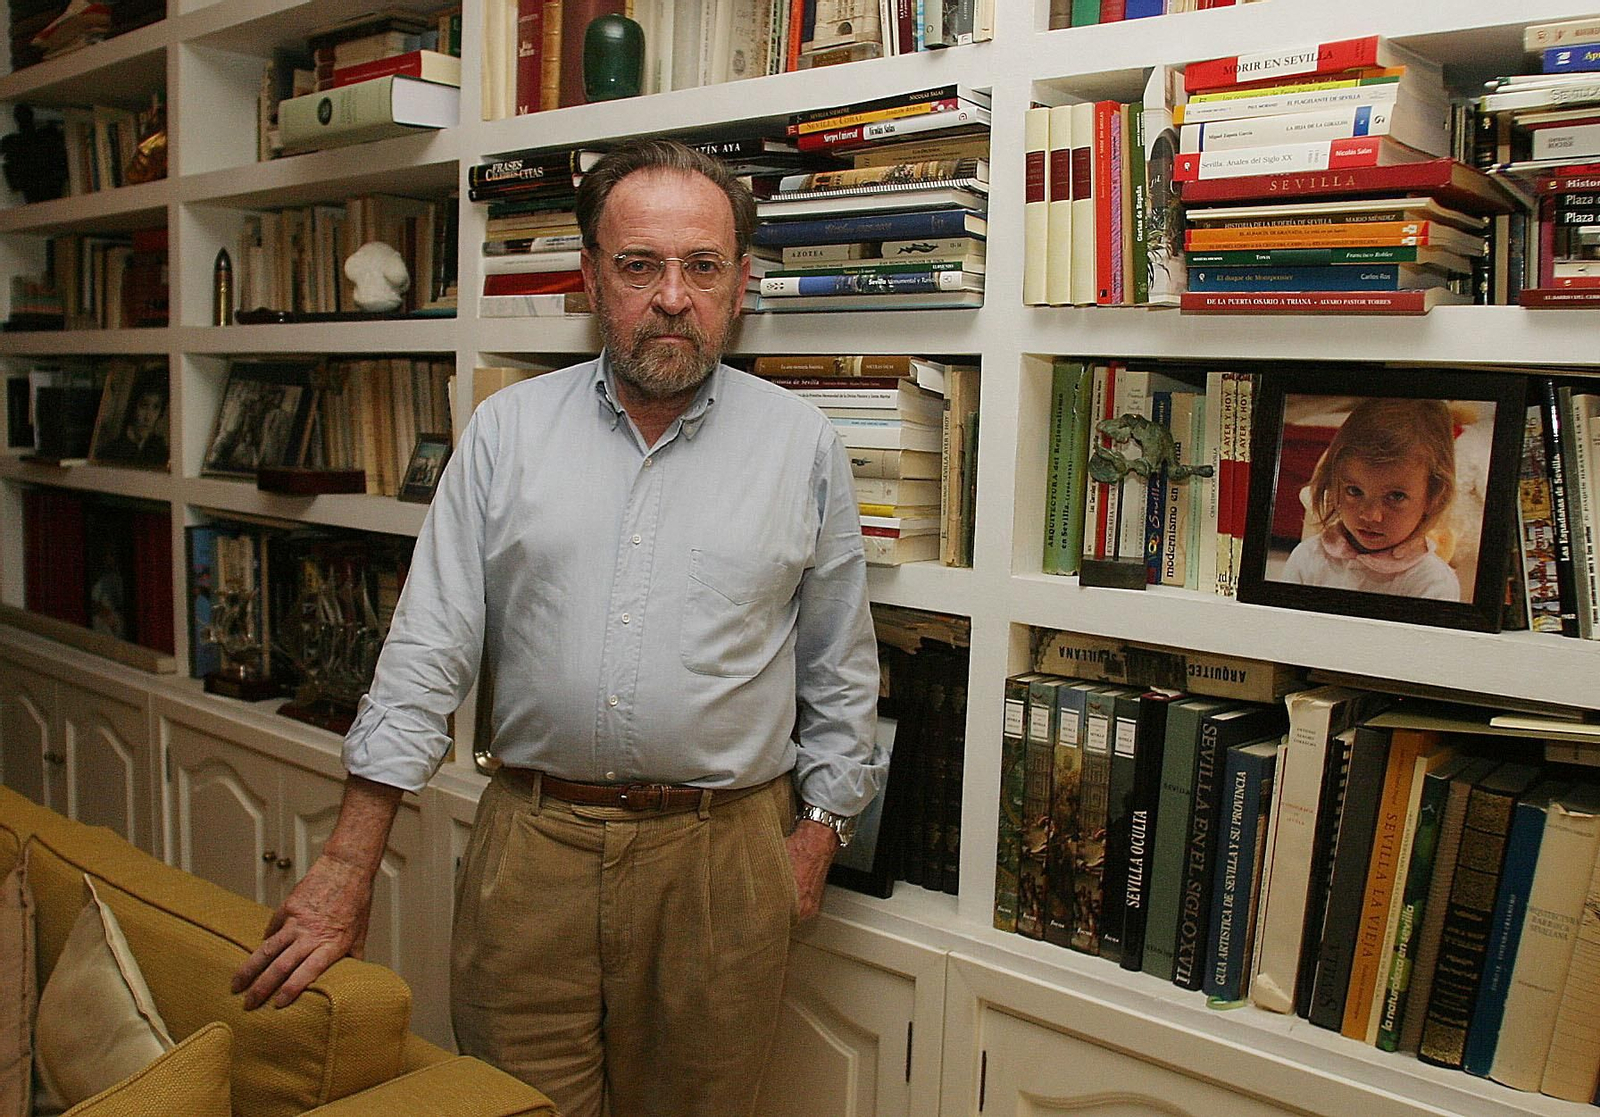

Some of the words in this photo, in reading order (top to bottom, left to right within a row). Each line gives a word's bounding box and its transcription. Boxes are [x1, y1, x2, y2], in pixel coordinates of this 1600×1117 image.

[1223, 60, 1260, 76] MORIR
[1265, 58, 1282, 69] EN
[1284, 51, 1333, 67] SEVILLA
[722, 142, 740, 152] AYA
[1336, 148, 1356, 156] Nicolás
[1357, 147, 1372, 155] Salas
[492, 159, 523, 172] FRASES
[1227, 158, 1249, 166] Anales
[1263, 156, 1279, 166] Siglo
[1270, 176, 1356, 191] SEVILLA
[1136, 184, 1144, 208] España
[1565, 194, 1593, 205] Plaza
[1136, 210, 1142, 218] de
[1565, 212, 1593, 223] Plaza
[792, 250, 823, 258] AZOTEA
[868, 278, 886, 286] Sevilla
[1224, 392, 1232, 412] HOY
[1240, 392, 1248, 412] HOY
[1048, 475, 1058, 547] ARQUITECTURA
[1055, 393, 1063, 456] Regionalismo
[1551, 452, 1563, 483] Sevilla
[1170, 488, 1178, 501] en
[1554, 485, 1564, 496] de
[1149, 479, 1160, 529] Sevilla
[1061, 537, 1067, 549] en
[1166, 506, 1177, 578] modernismo
[1192, 722, 1218, 811] SEVILLA
[1230, 770, 1247, 825] PROVINCIA
[1128, 808, 1149, 855] OCULTA
[1190, 815, 1209, 846] EN
[1229, 826, 1240, 840] SU
[1228, 841, 1239, 849] Y
[1374, 812, 1398, 881] SEVILLA
[1187, 848, 1205, 878] EL
[1223, 850, 1239, 891] SEVILLA
[1123, 856, 1145, 908] SEVILLA
[1180, 878, 1202, 940] SIGLO
[1222, 892, 1234, 907] DE
[1369, 888, 1385, 909] LA
[1396, 902, 1415, 943] sevilla
[1216, 908, 1233, 960] ARTISTICA
[1358, 914, 1380, 959] VIEJA
[1397, 942, 1408, 958] en
[1174, 938, 1195, 985] XVII
[1213, 960, 1227, 985] GUIA
[1385, 956, 1405, 1020] naturaleza
[1381, 1017, 1393, 1031] la
